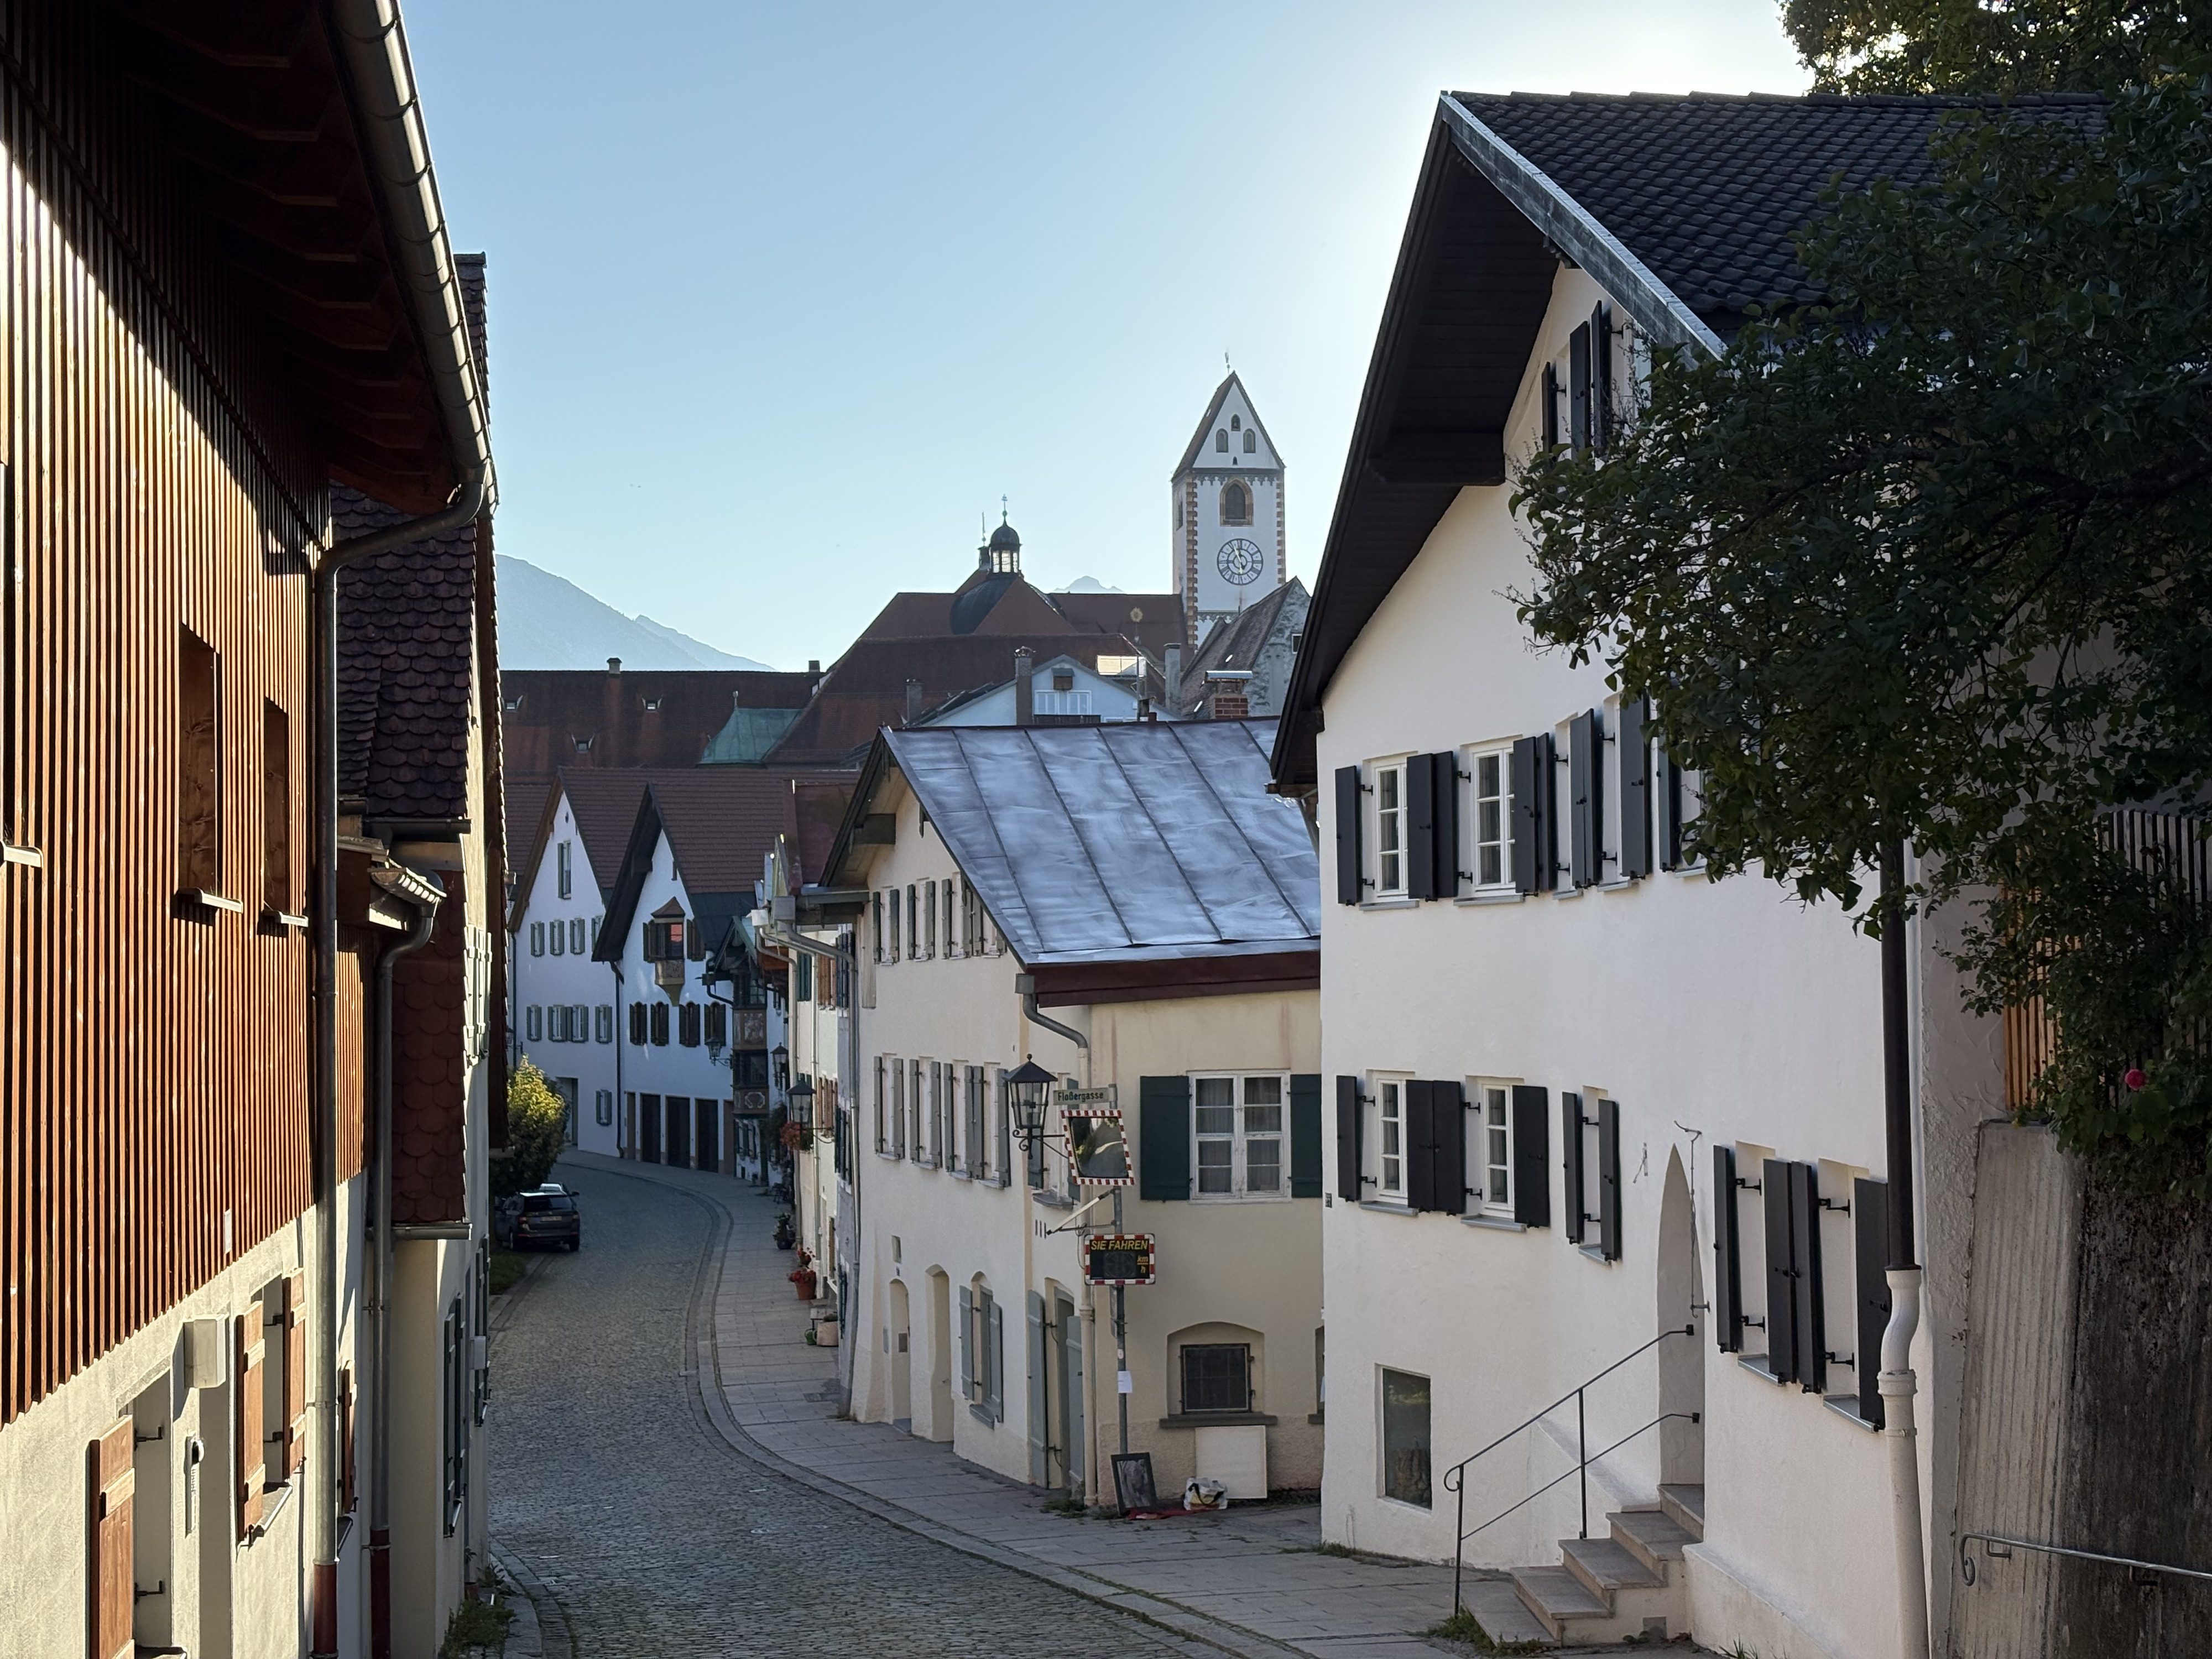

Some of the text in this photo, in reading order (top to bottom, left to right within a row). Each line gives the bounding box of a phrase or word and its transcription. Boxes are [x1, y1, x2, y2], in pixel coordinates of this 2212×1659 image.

[1057, 1091, 1104, 1102] Floßergasse
[1091, 1240, 1148, 1250] SIE FAHREN
[1140, 1265, 1146, 1274] h
